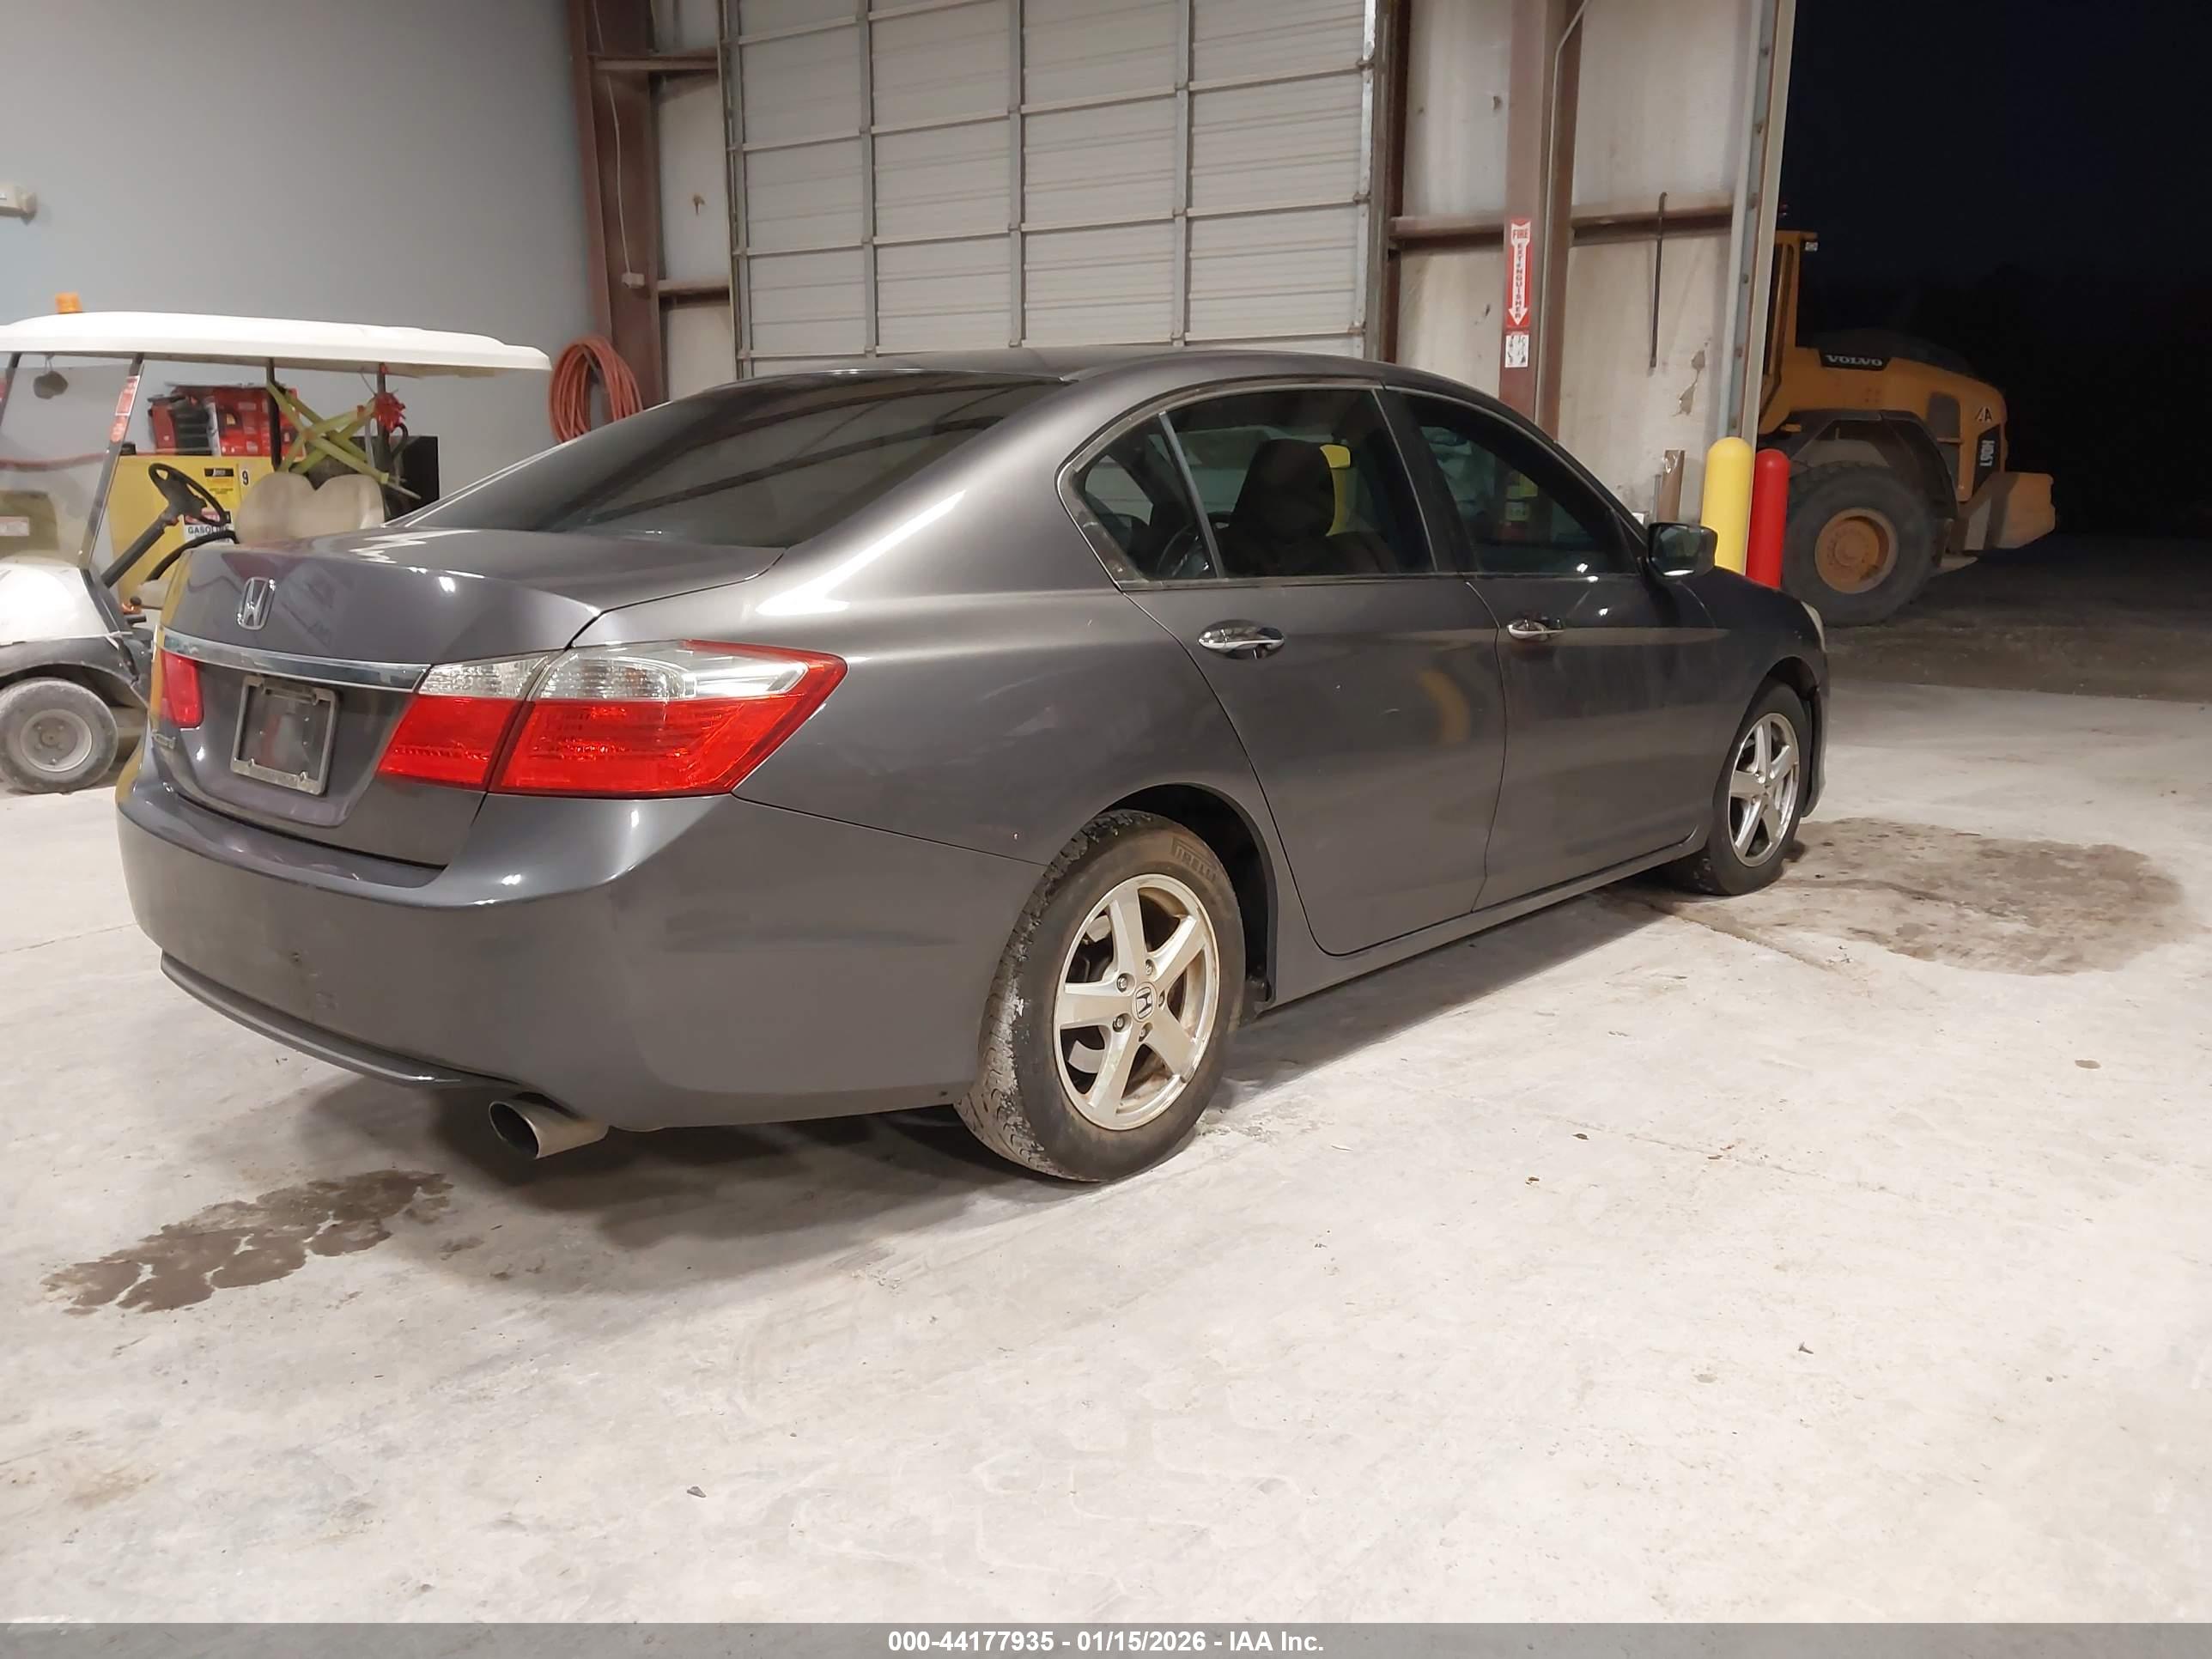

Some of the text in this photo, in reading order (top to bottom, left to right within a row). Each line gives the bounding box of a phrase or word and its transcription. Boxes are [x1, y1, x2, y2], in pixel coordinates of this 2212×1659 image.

[1512, 229, 1528, 240] FIRE
[1515, 242, 1523, 319] EXTINGUISHER
[1825, 355, 1883, 367] VOLVO
[1979, 440, 1995, 466] L90H
[241, 470, 250, 486] 9
